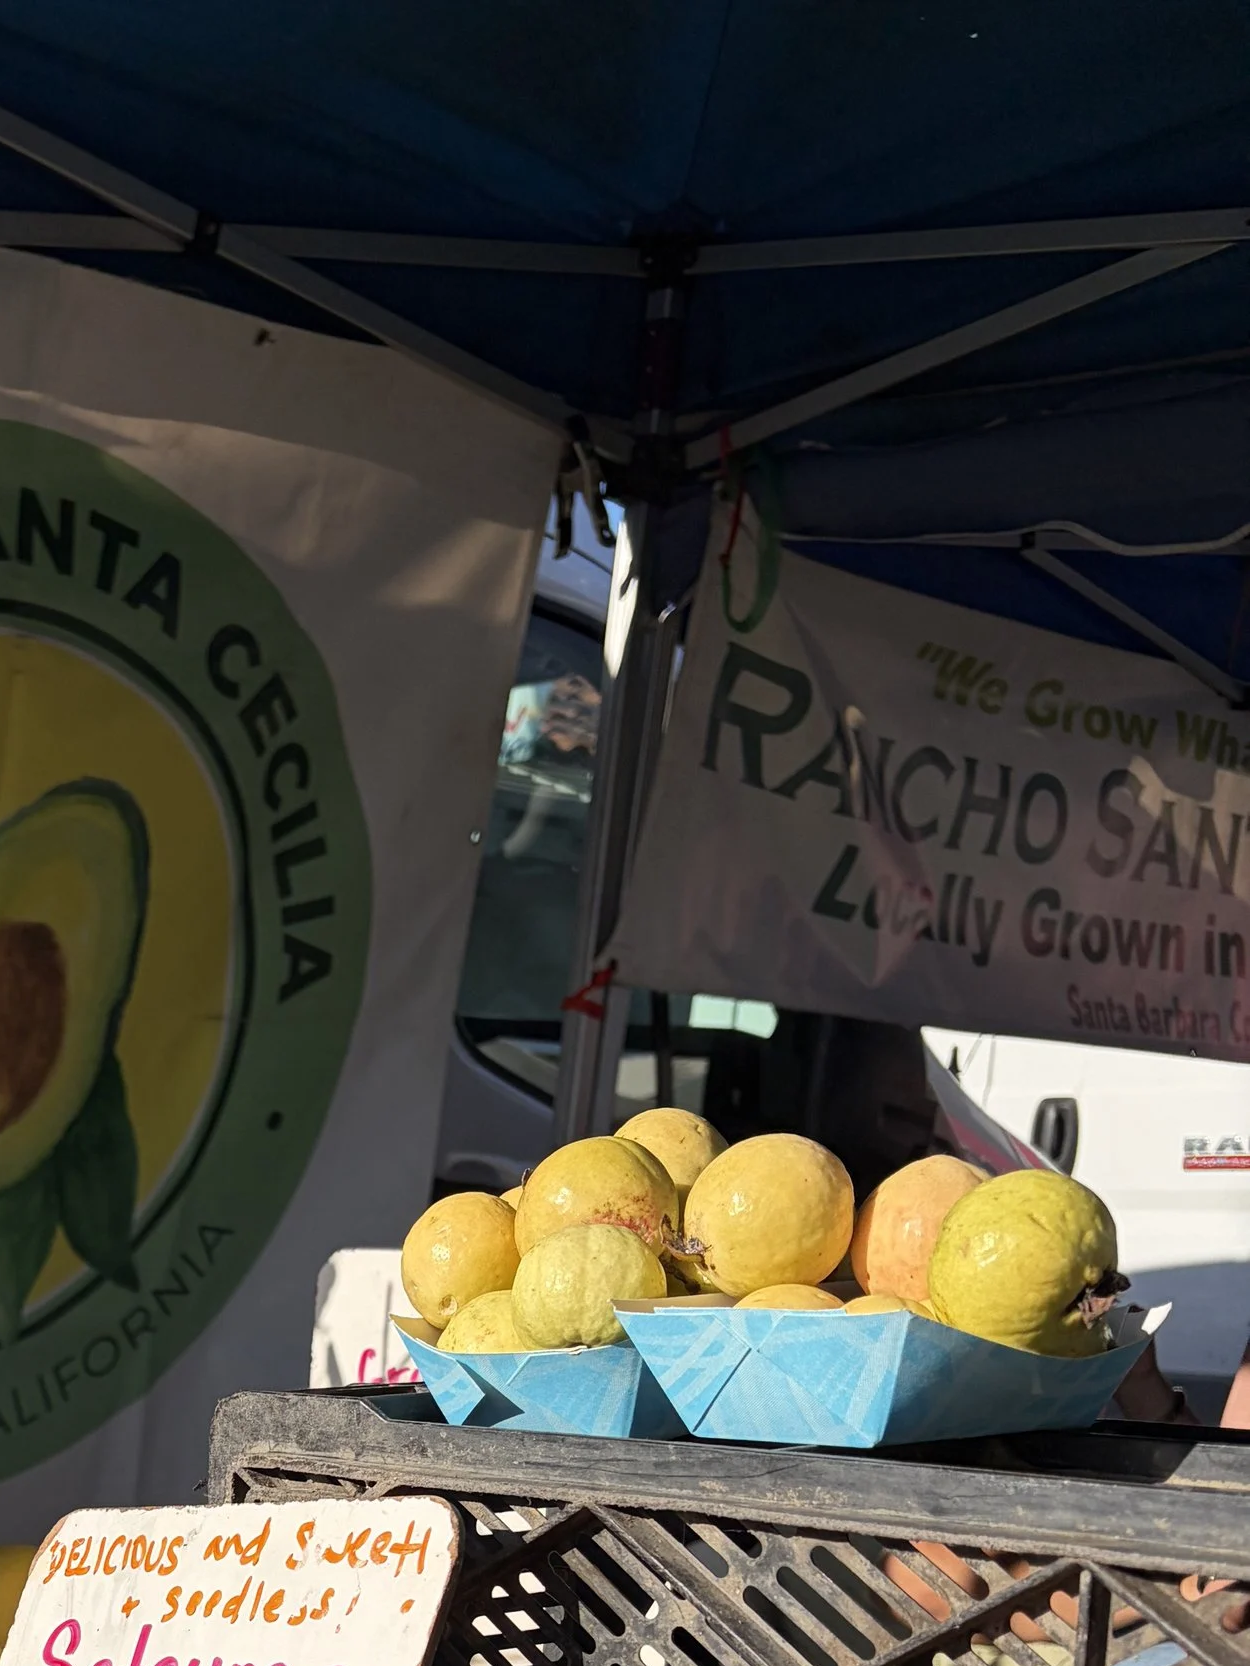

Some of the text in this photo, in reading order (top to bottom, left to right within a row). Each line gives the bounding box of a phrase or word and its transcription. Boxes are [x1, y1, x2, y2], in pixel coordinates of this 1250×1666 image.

[1024, 678, 1158, 749] Grow
[700, 640, 1250, 899] RANCHO SAN
[205, 623, 337, 1004] CECILIA
[1021, 887, 1185, 973] Grown
[1205, 913, 1247, 979] in
[1067, 984, 1132, 1033] Santa
[1134, 992, 1221, 1043] Barbara
[1184, 1136, 1250, 1154] RA
[43, 1534, 184, 1585] DELICIOUS
[204, 1517, 272, 1567] and
